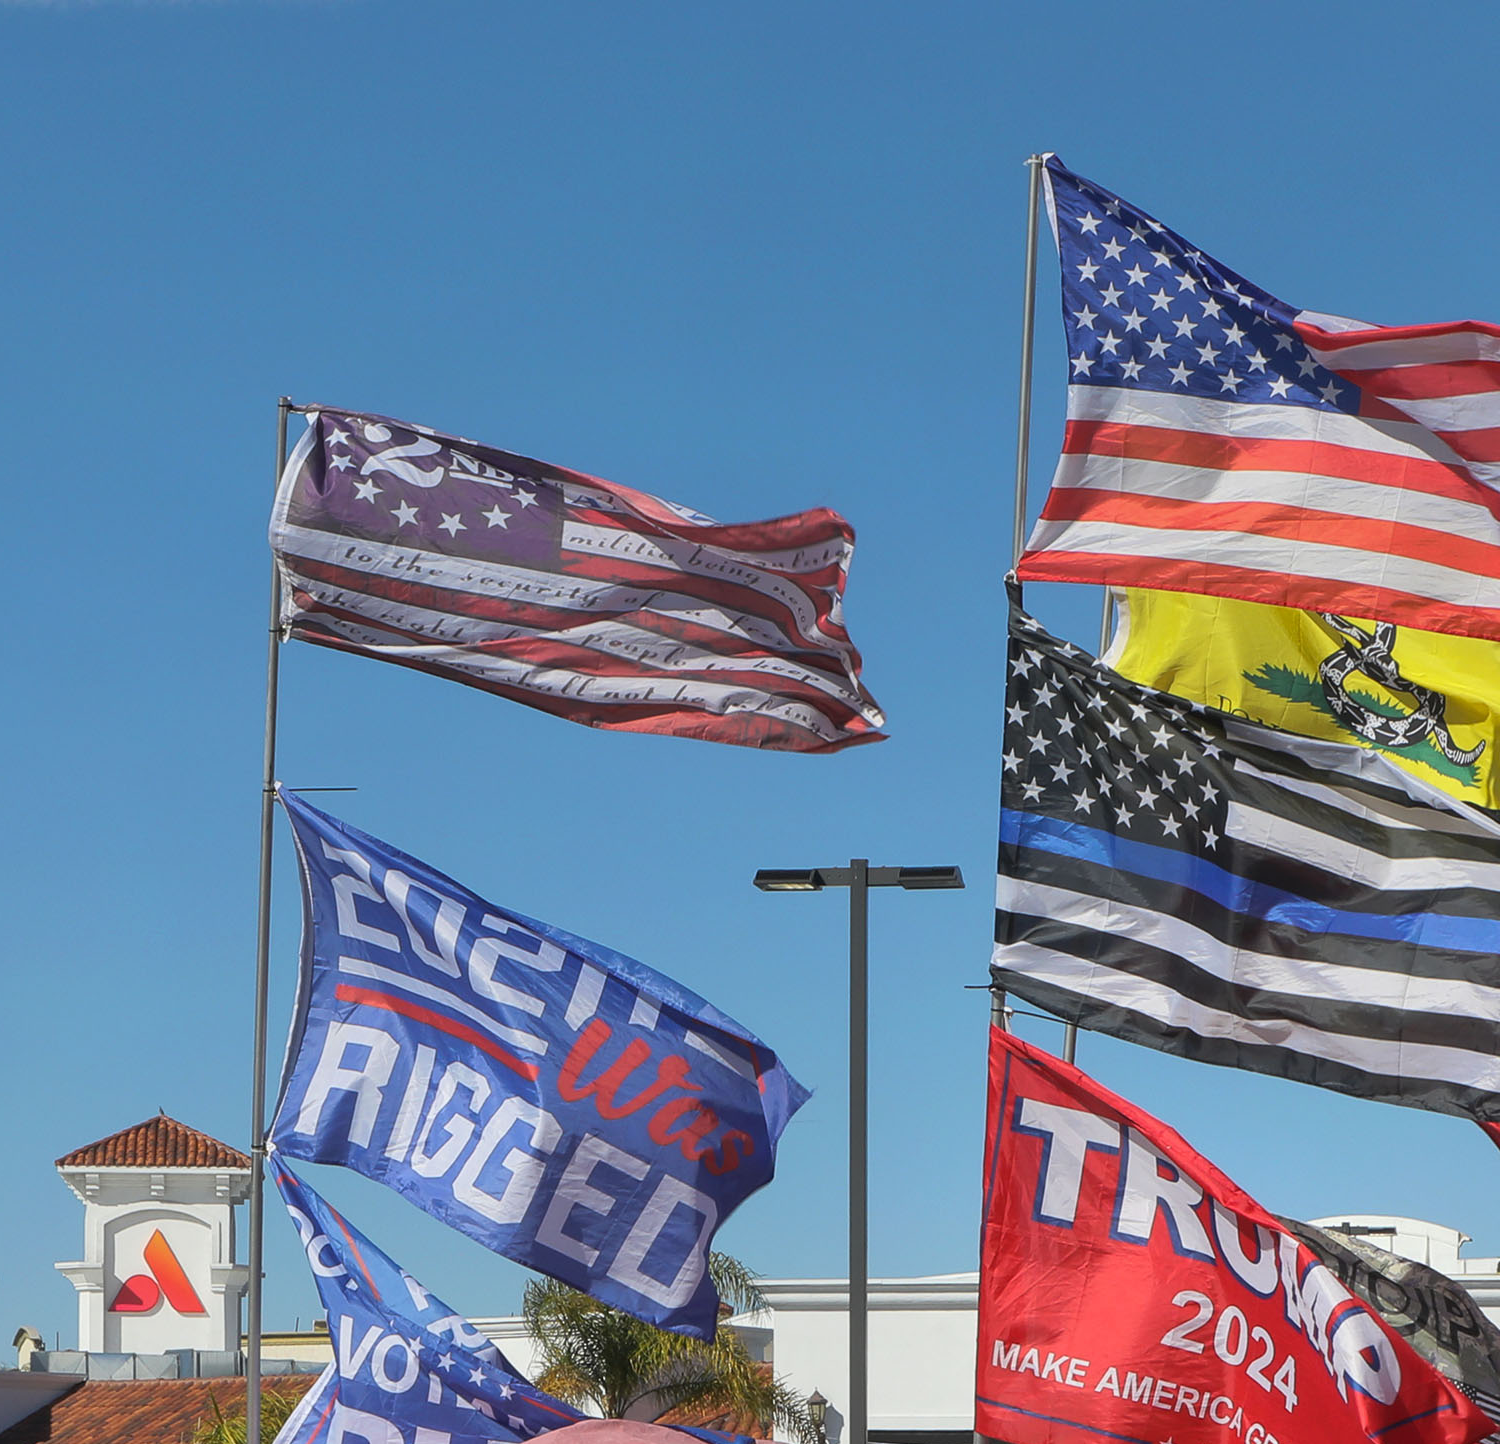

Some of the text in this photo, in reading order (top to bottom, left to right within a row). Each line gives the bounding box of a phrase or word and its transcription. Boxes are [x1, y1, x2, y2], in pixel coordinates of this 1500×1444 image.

[345, 547, 372, 564] to
[569, 533, 674, 562] militia
[687, 543, 760, 584] being
[557, 1017, 756, 1177] Was
[294, 1019, 719, 1310] RIGGED
[1012, 1096, 1402, 1406] TRUMP
[991, 1339, 1090, 1388] MAKE
[1095, 1366, 1244, 1438] AMERICA
[1159, 1289, 1299, 1415] 2024
